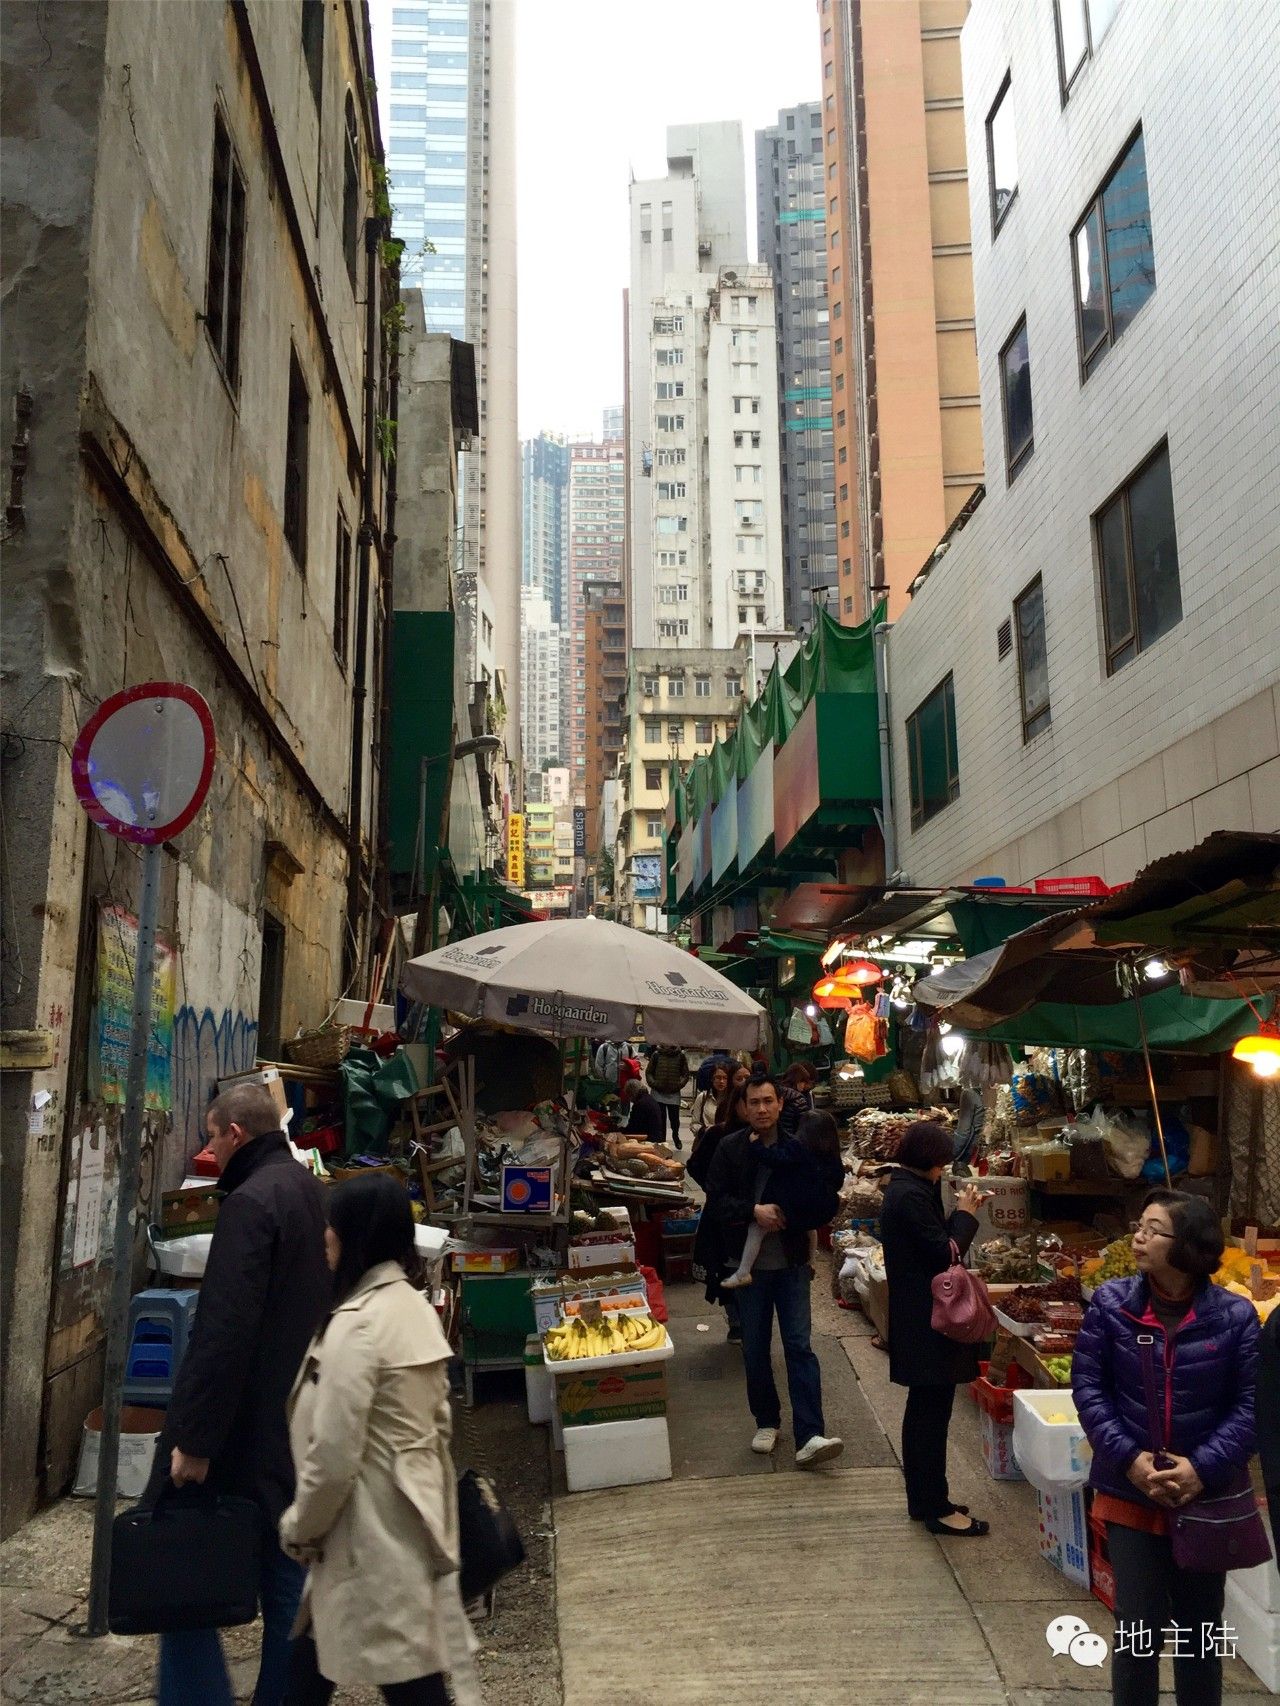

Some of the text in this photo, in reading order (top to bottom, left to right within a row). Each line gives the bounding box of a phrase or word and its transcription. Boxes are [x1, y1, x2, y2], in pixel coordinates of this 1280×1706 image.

[575, 811, 585, 847] shama
[645, 981, 729, 1001] Hoegaarden
[532, 997, 609, 1024] Hoegaarden
[994, 1208, 1026, 1220] 888
